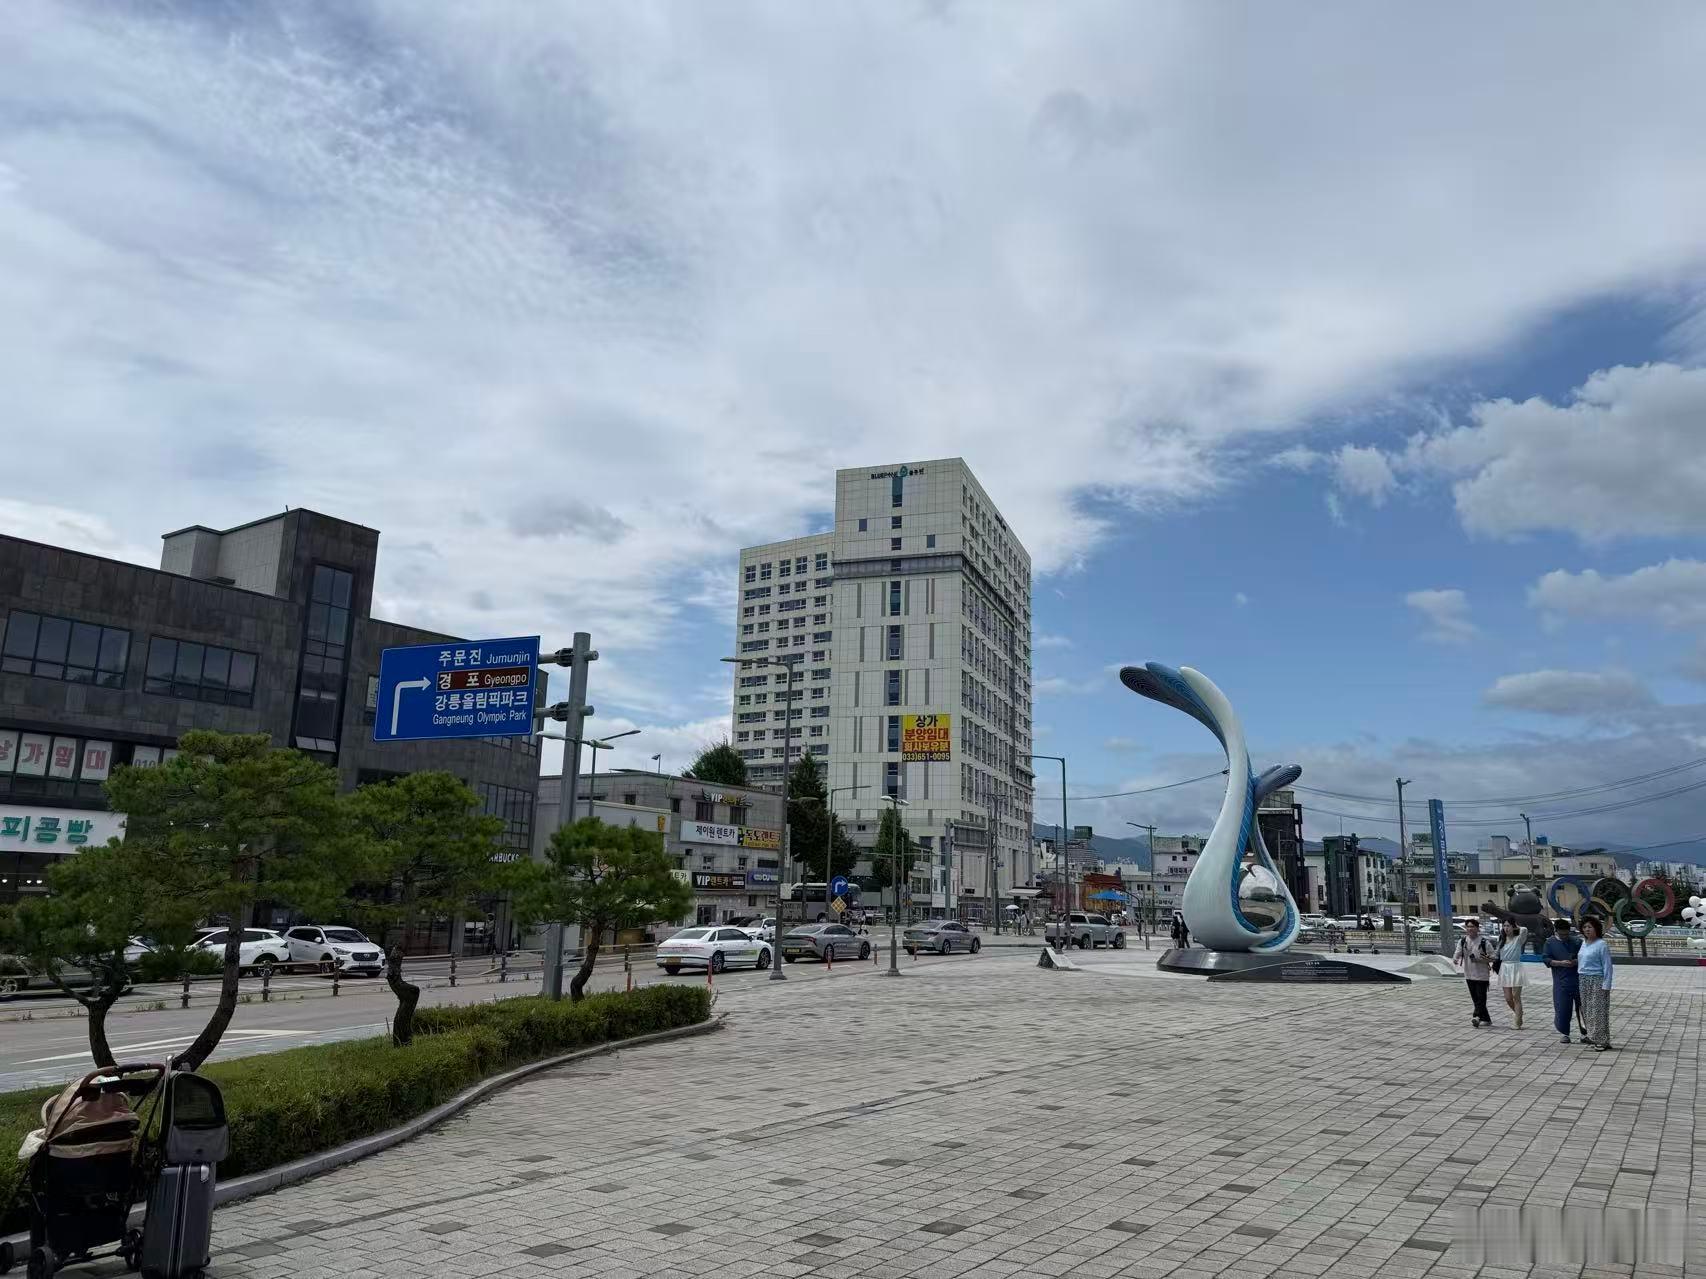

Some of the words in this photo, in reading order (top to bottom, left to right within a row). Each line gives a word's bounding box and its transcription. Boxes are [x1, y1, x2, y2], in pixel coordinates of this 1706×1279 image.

[438, 648, 482, 667] 주문진
[486, 651, 530, 665] Jumunjin
[484, 674, 527, 688] Gyeongpo
[435, 691, 528, 711] 강릉올림픽파크
[433, 713, 474, 727] Gangneung
[477, 711, 507, 725] Olympic
[509, 710, 527, 721] Park
[915, 715, 939, 728] 상가
[904, 728, 949, 741] 분양임대
[695, 825, 716, 838] 제이원
[716, 827, 736, 839] 렌트카
[672, 871, 687, 882] 트카
